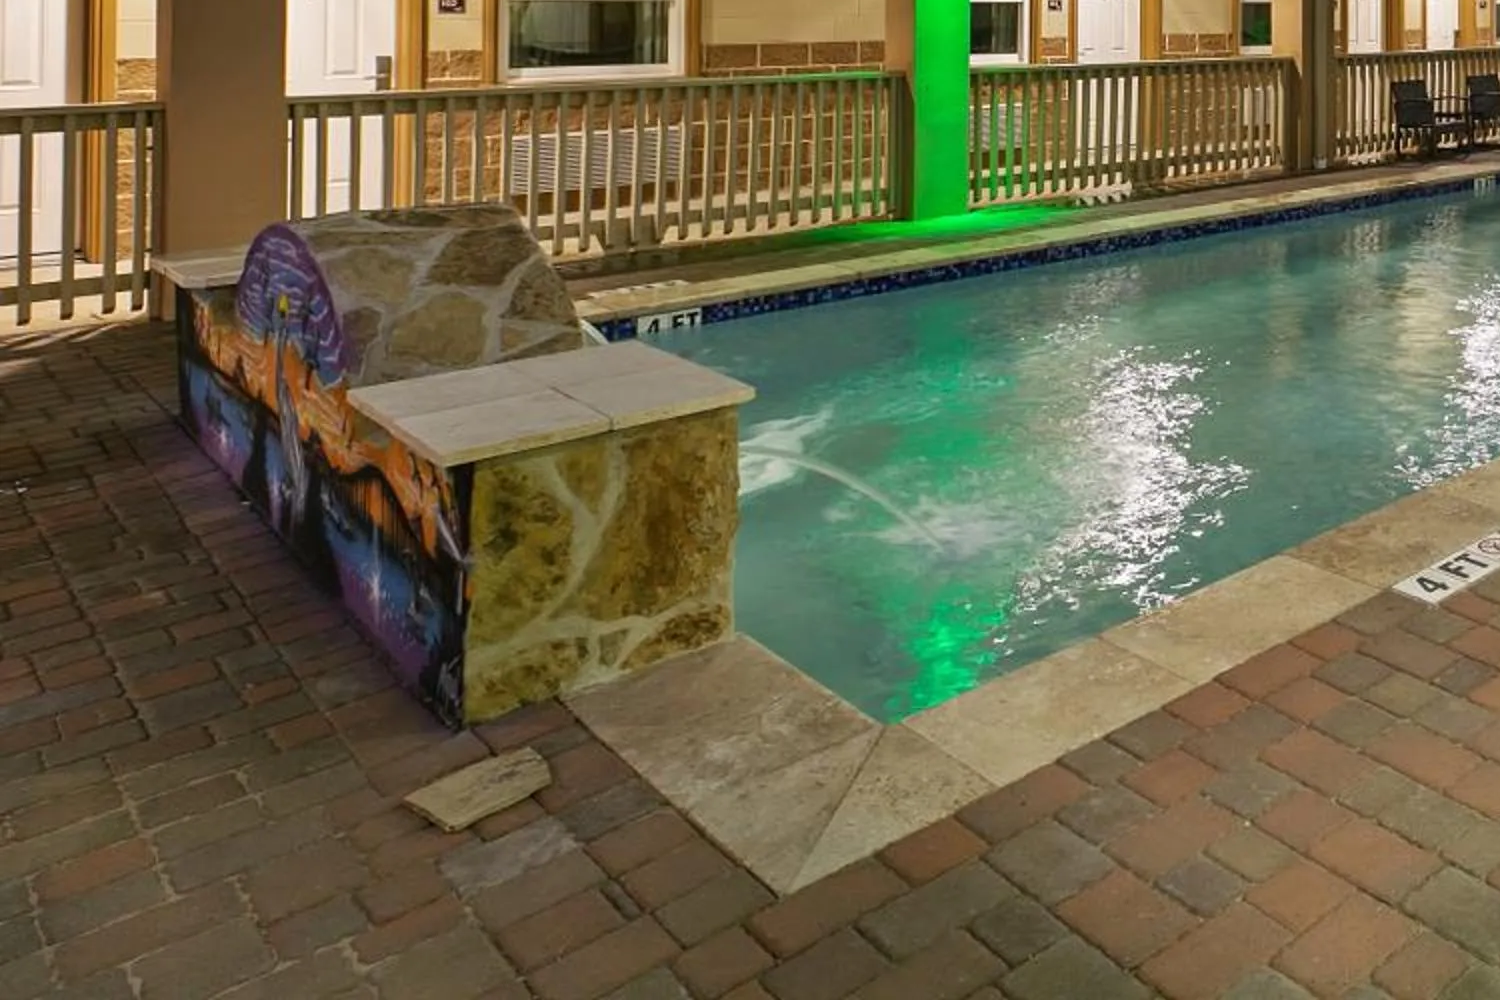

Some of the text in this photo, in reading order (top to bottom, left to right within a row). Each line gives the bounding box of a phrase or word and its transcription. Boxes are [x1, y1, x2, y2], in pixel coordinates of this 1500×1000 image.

[672, 311, 699, 329] FT
[1416, 553, 1489, 593] 4 FT
